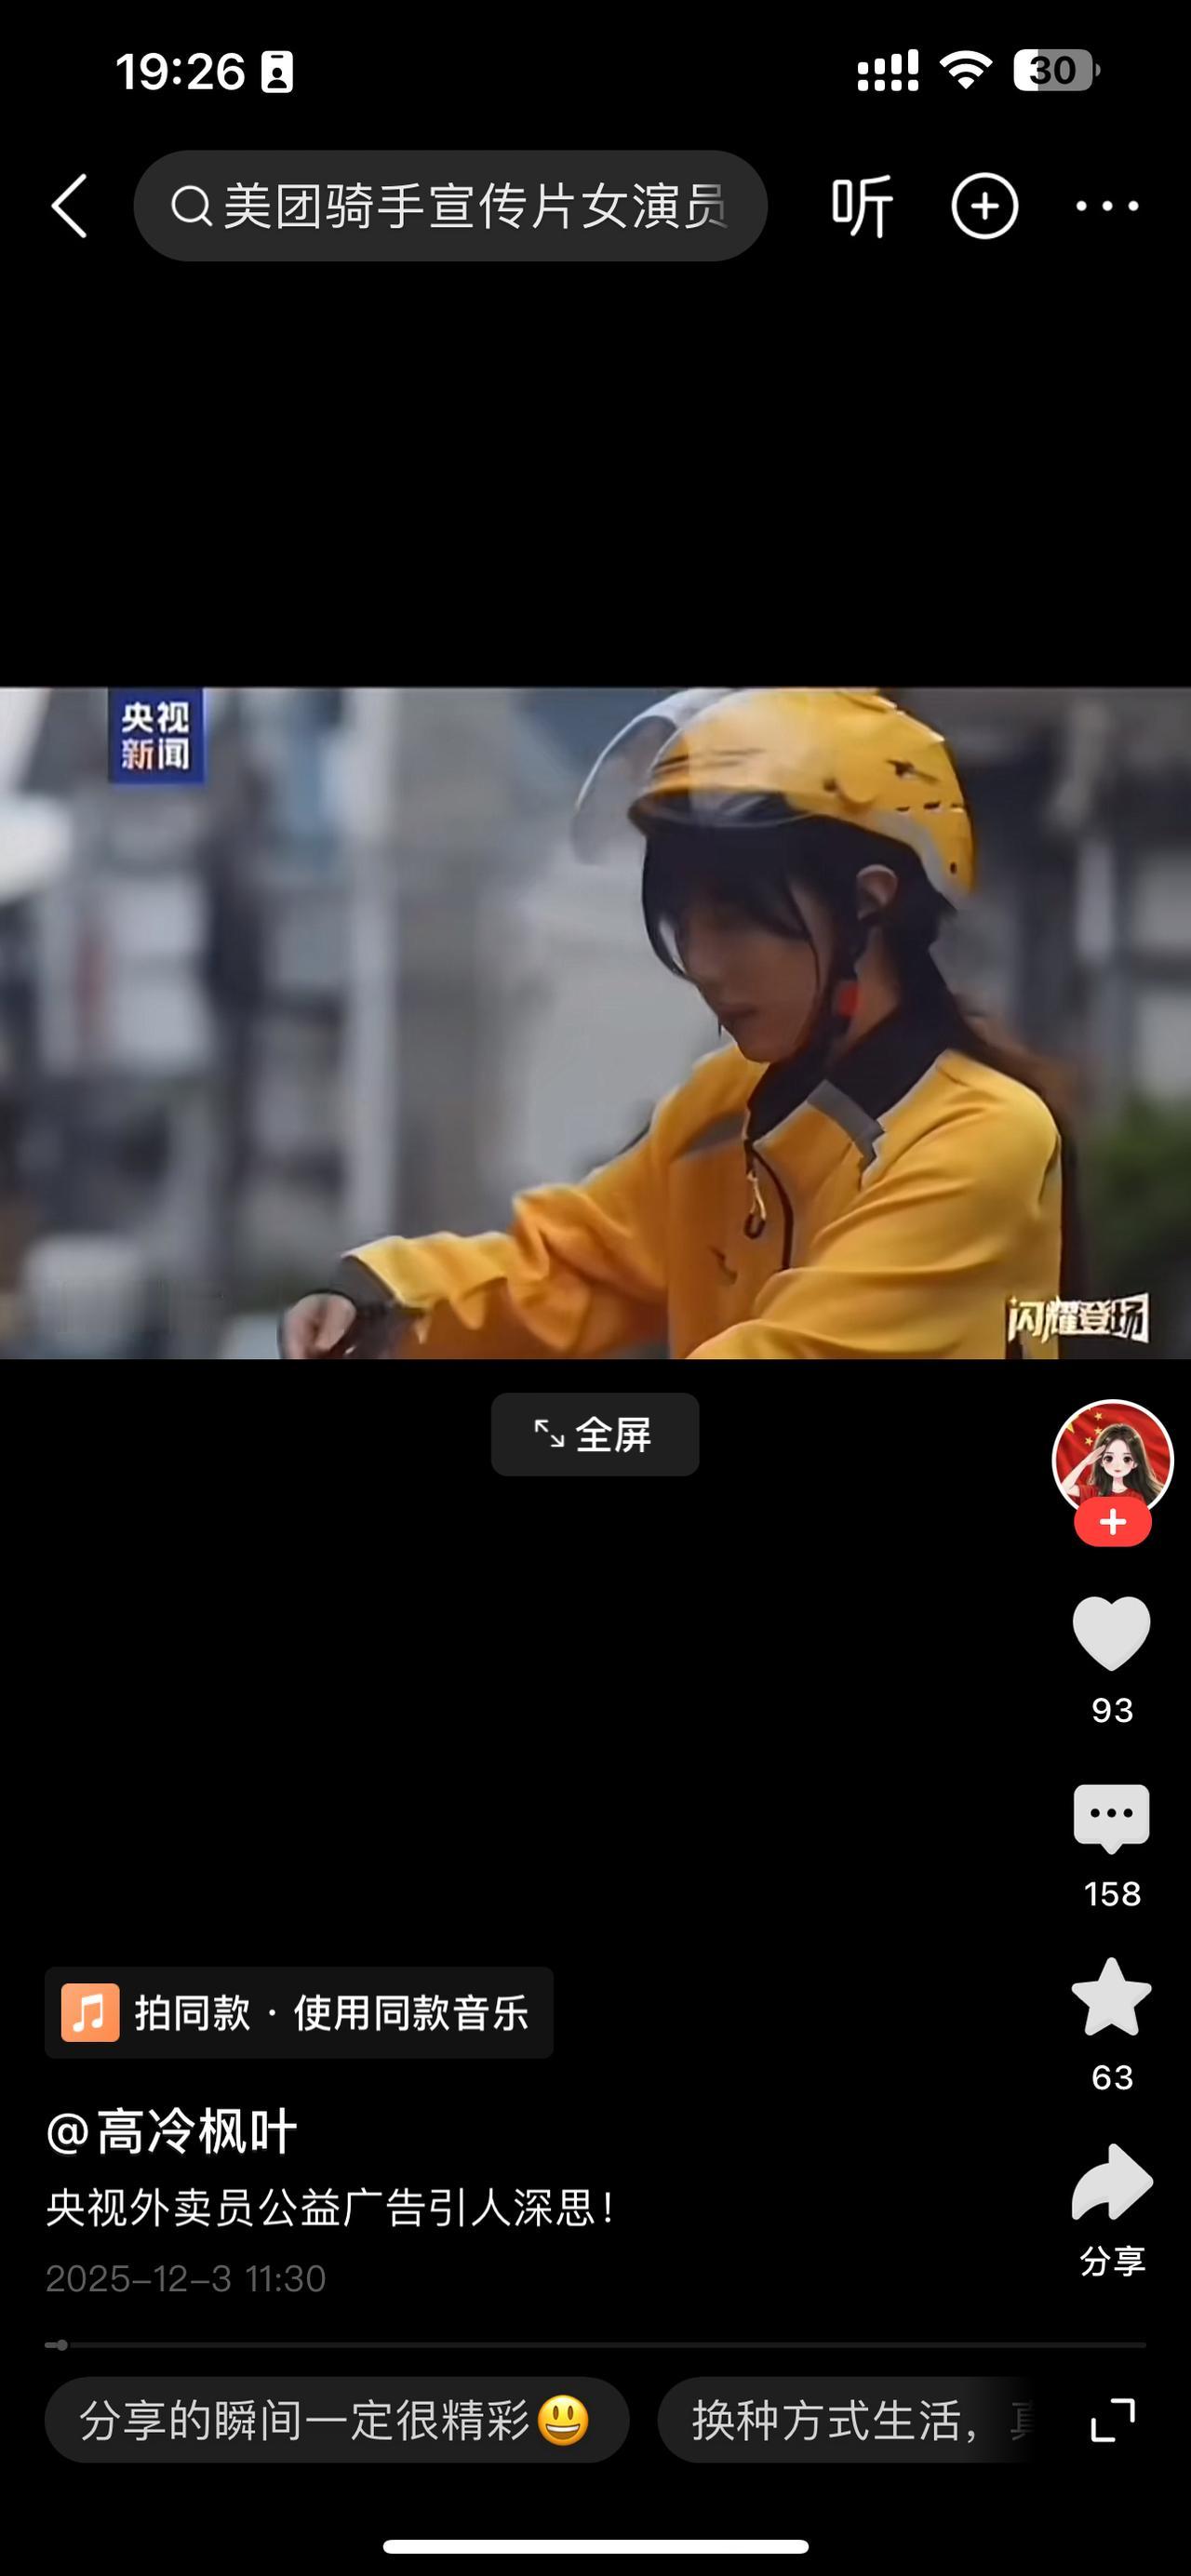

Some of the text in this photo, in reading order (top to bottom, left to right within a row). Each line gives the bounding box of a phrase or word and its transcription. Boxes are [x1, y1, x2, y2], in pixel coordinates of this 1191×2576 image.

[116, 52, 246, 91] 19:26
[1029, 55, 1076, 85] 30
[223, 181, 729, 231] 美团骑手宣传片女演员
[832, 174, 894, 239] 听
[575, 1415, 652, 1453] 全屏
[1091, 1697, 1133, 1724] 93
[1084, 1880, 1142, 1907] 158
[135, 1994, 250, 2032] 拍同款
[293, 1993, 529, 2032] 使用同款音乐
[1091, 2064, 1133, 2091] 63
[47, 2106, 298, 2156] @高冷枫叶
[47, 2186, 613, 2228] 央视外卖员公益广告引人深思！
[246, 2264, 327, 2292] 11:30
[1079, 2245, 1146, 2277] 分享
[79, 2398, 529, 2442] 分享的瞬间一定很精彩
